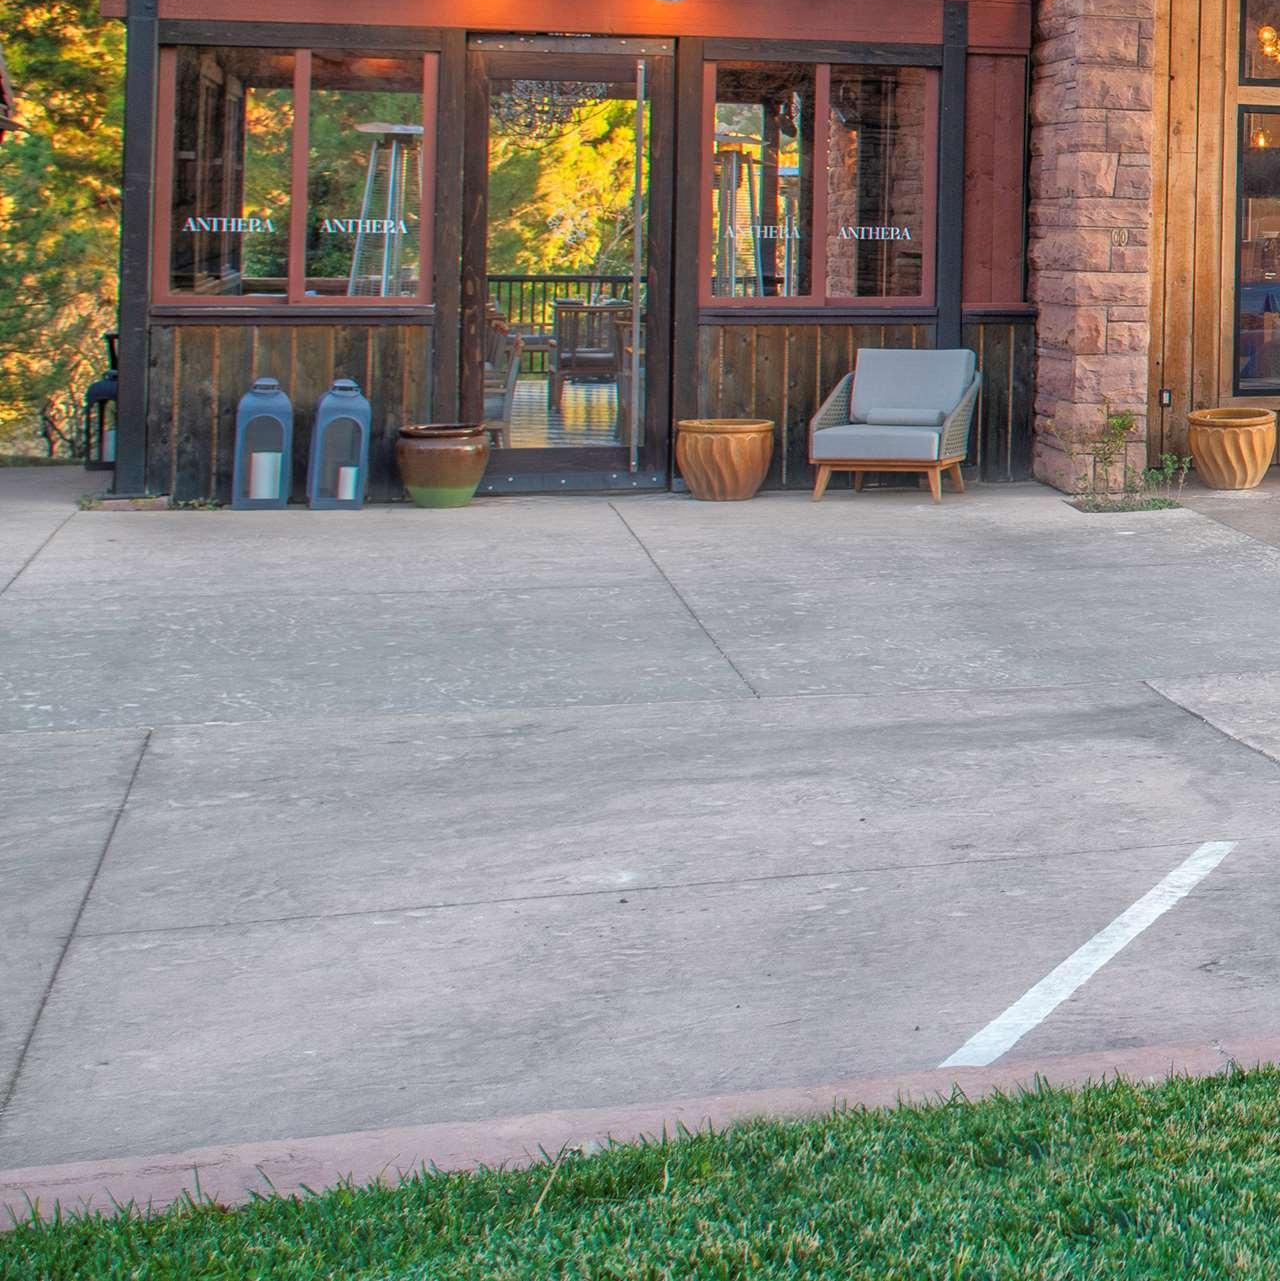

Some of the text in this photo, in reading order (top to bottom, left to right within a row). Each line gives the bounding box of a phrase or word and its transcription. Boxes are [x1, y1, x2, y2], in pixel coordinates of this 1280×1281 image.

[182, 217, 276, 233] ANTHERA
[320, 219, 409, 234] ANTHERA
[724, 225, 801, 239] ANTHERA
[837, 226, 912, 240] ANTHERA
